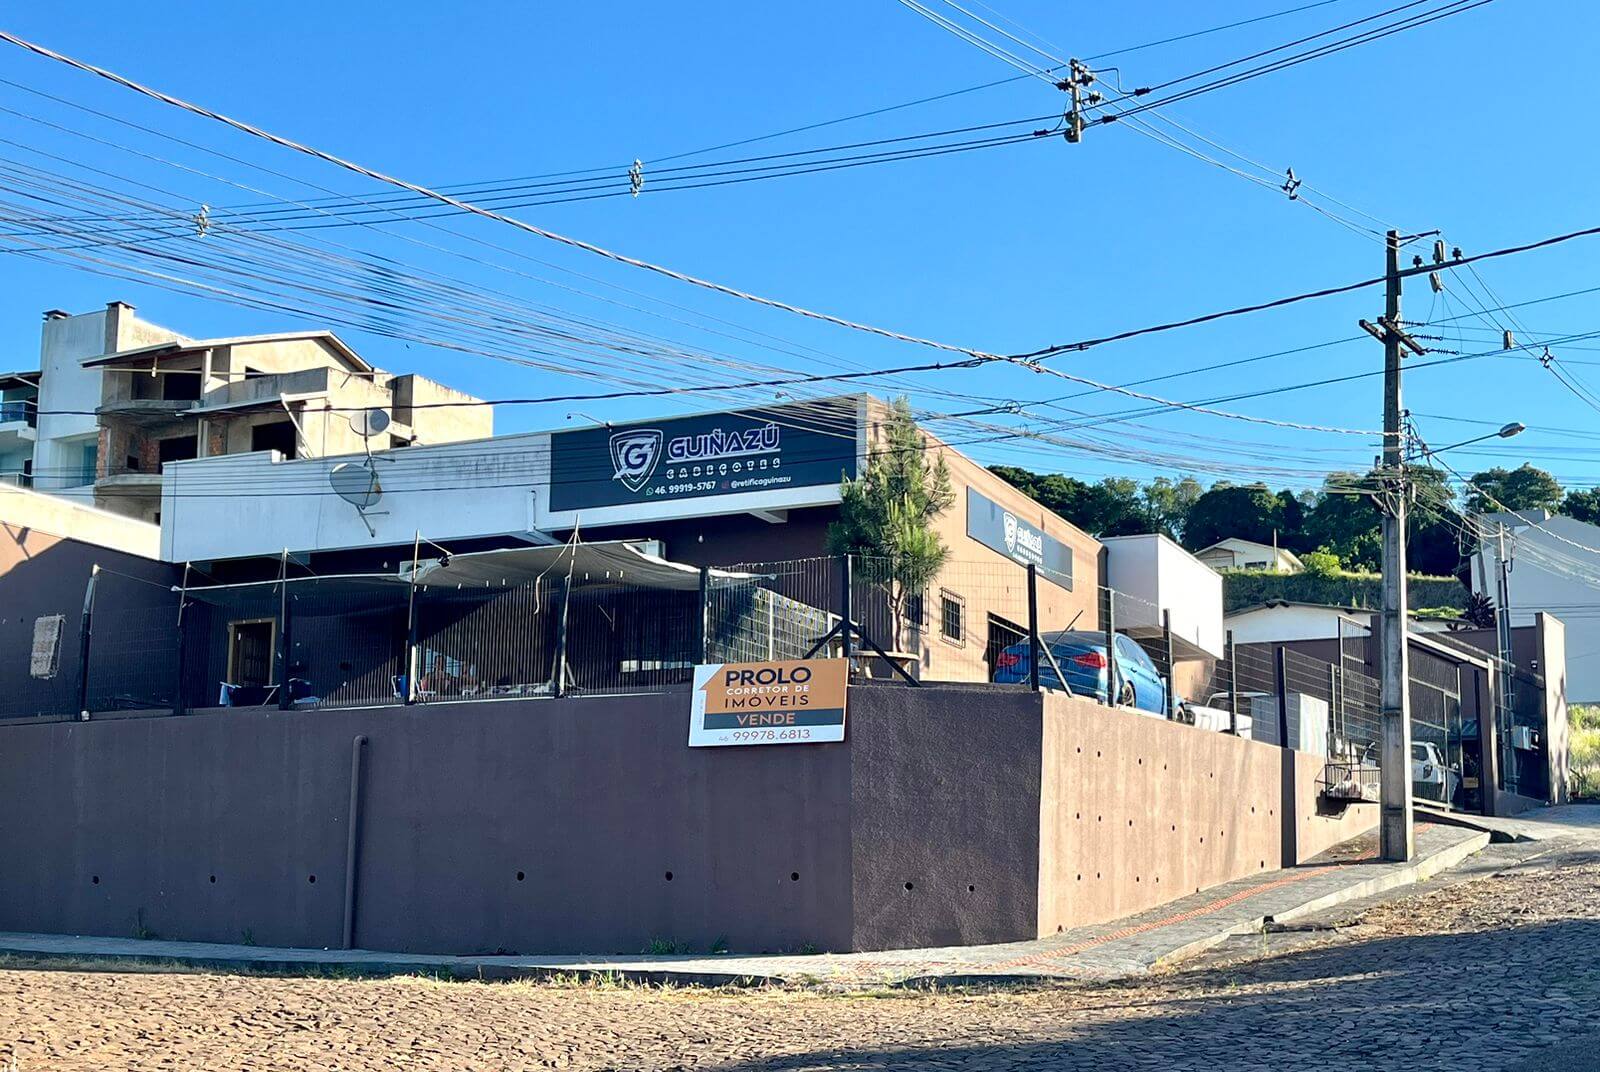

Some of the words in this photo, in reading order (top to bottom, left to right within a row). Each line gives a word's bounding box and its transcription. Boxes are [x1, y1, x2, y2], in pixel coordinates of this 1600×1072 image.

[668, 423, 780, 458] GUIÑAZÚ
[668, 480, 716, 494] 99919-5767
[725, 666, 812, 687] PROLO
[726, 685, 789, 696] CORRETOR
[795, 684, 810, 693] DE
[725, 694, 809, 708] IMÓVEIS
[736, 712, 796, 726] VENDE
[732, 729, 810, 741] 99978.6813
